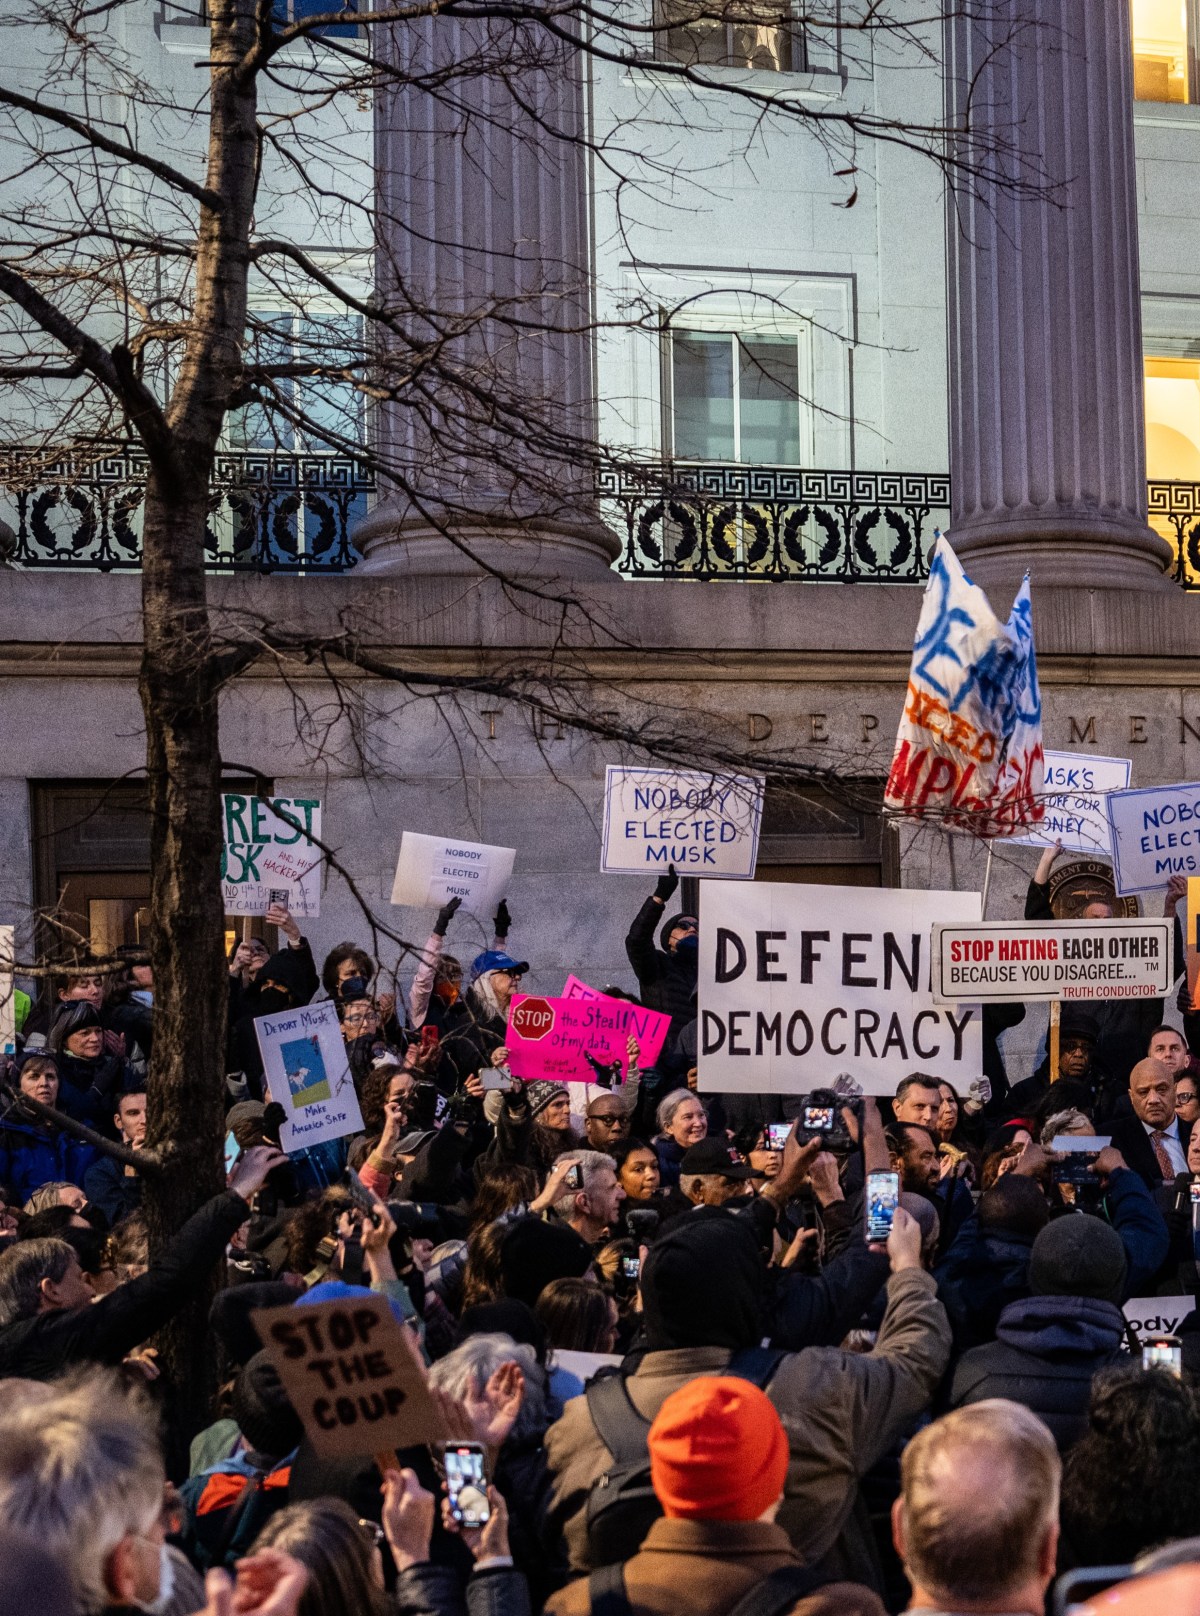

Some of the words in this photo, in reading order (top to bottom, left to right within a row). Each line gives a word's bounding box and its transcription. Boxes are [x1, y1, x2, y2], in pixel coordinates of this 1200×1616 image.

[634, 787, 731, 813] NOBODY
[224, 794, 320, 846] REST
[1043, 816, 1084, 834] ONEY
[625, 820, 737, 843] ELECTED
[278, 850, 294, 864] AND
[445, 848, 482, 860] NOBODY
[646, 845, 716, 864] MUSK
[442, 867, 480, 879] ELECTED
[1088, 863, 1102, 873] OF
[225, 885, 239, 898] NO
[257, 885, 294, 897] BRH
[446, 886, 471, 896] MUSK
[715, 927, 932, 993] DEFEN
[951, 940, 994, 963] STOP
[998, 938, 1058, 961] HATING
[1062, 937, 1104, 959] EACH
[1109, 936, 1159, 958] OTHER
[951, 965, 1017, 983] BECAUSE
[1021, 965, 1050, 981] YOU
[1054, 963, 1137, 981] DISAGREE...
[1145, 962, 1159, 972] TM
[1062, 986, 1094, 998] TRUTH
[1096, 984, 1156, 997] CONDUCTOR
[516, 1009, 551, 1028] STOP
[561, 1012, 578, 1027] the
[582, 1006, 628, 1034] Steal!
[701, 1007, 974, 1061] DEMOCRACY
[568, 1036, 586, 1057] my
[587, 1034, 611, 1050] data
[270, 1309, 380, 1359] STOP
[1128, 1315, 1179, 1334] ody
[307, 1350, 393, 1390] THE
[313, 1388, 407, 1430] COUP
